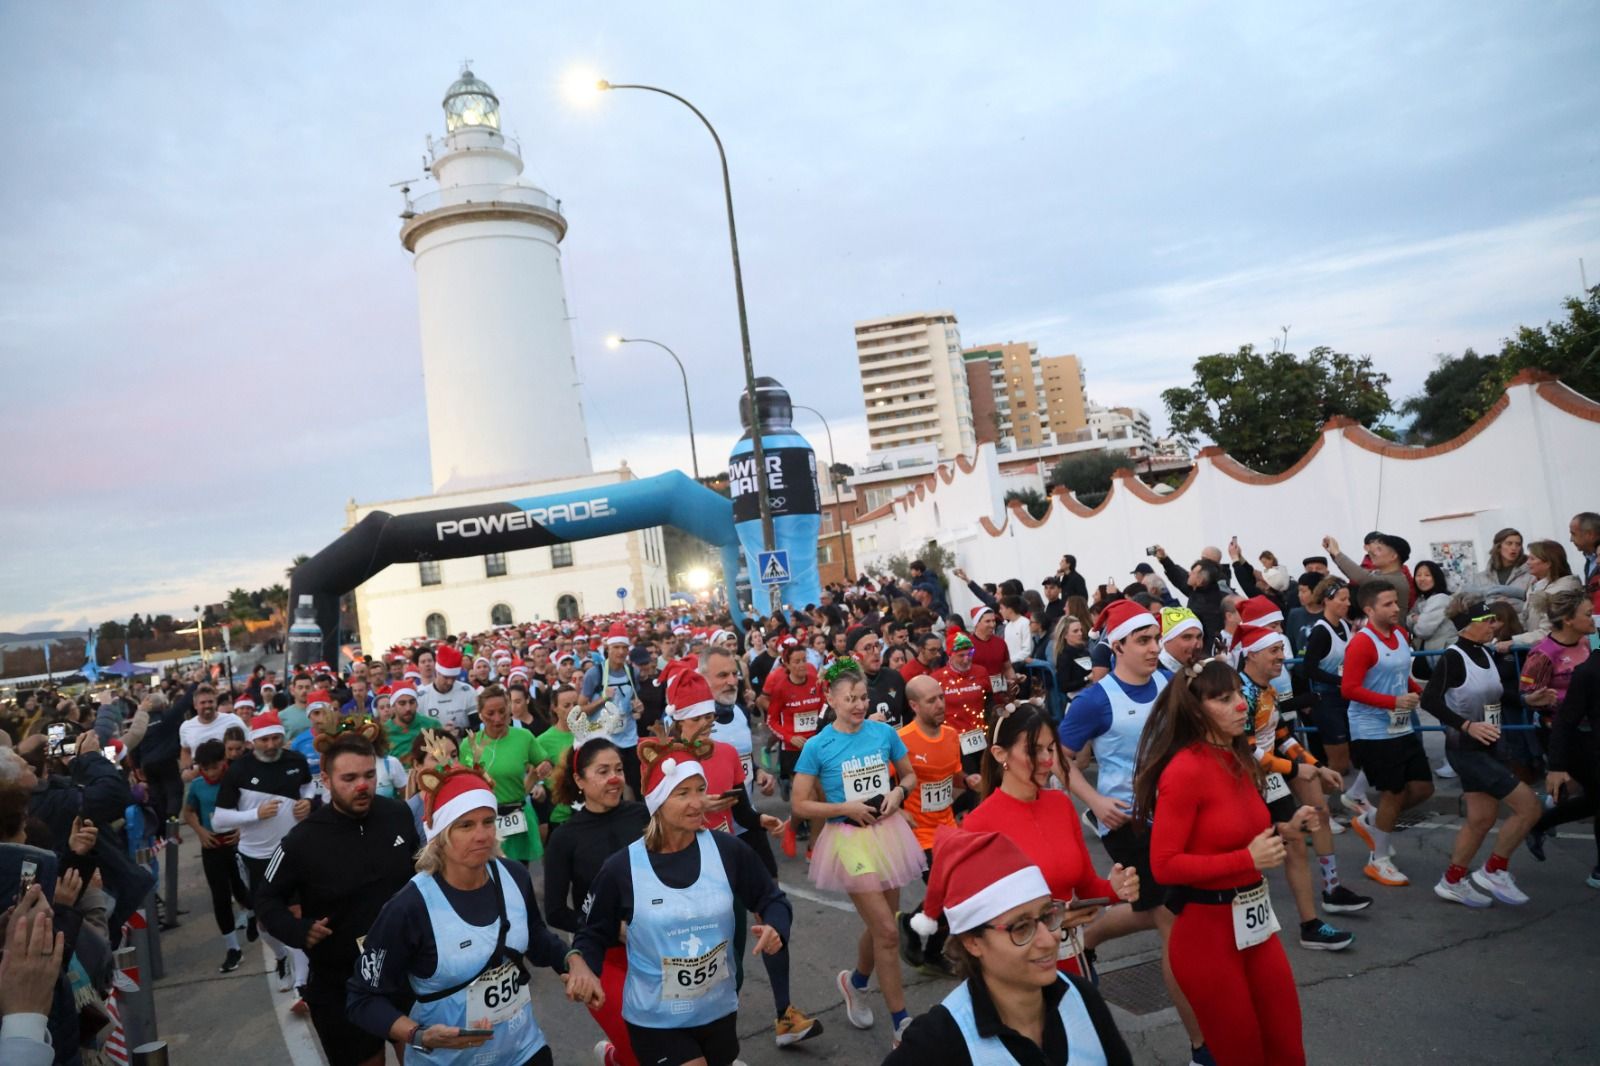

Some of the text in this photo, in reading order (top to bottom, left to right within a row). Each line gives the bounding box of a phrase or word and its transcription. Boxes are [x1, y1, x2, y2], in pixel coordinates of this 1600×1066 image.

[436, 497, 610, 541] POWERADE
[799, 717, 816, 726] 375
[966, 735, 983, 747] 181
[853, 774, 882, 792] 676
[924, 784, 951, 803] 1179
[496, 814, 519, 829] 780
[677, 958, 718, 987] 655
[484, 970, 520, 1008] 656
